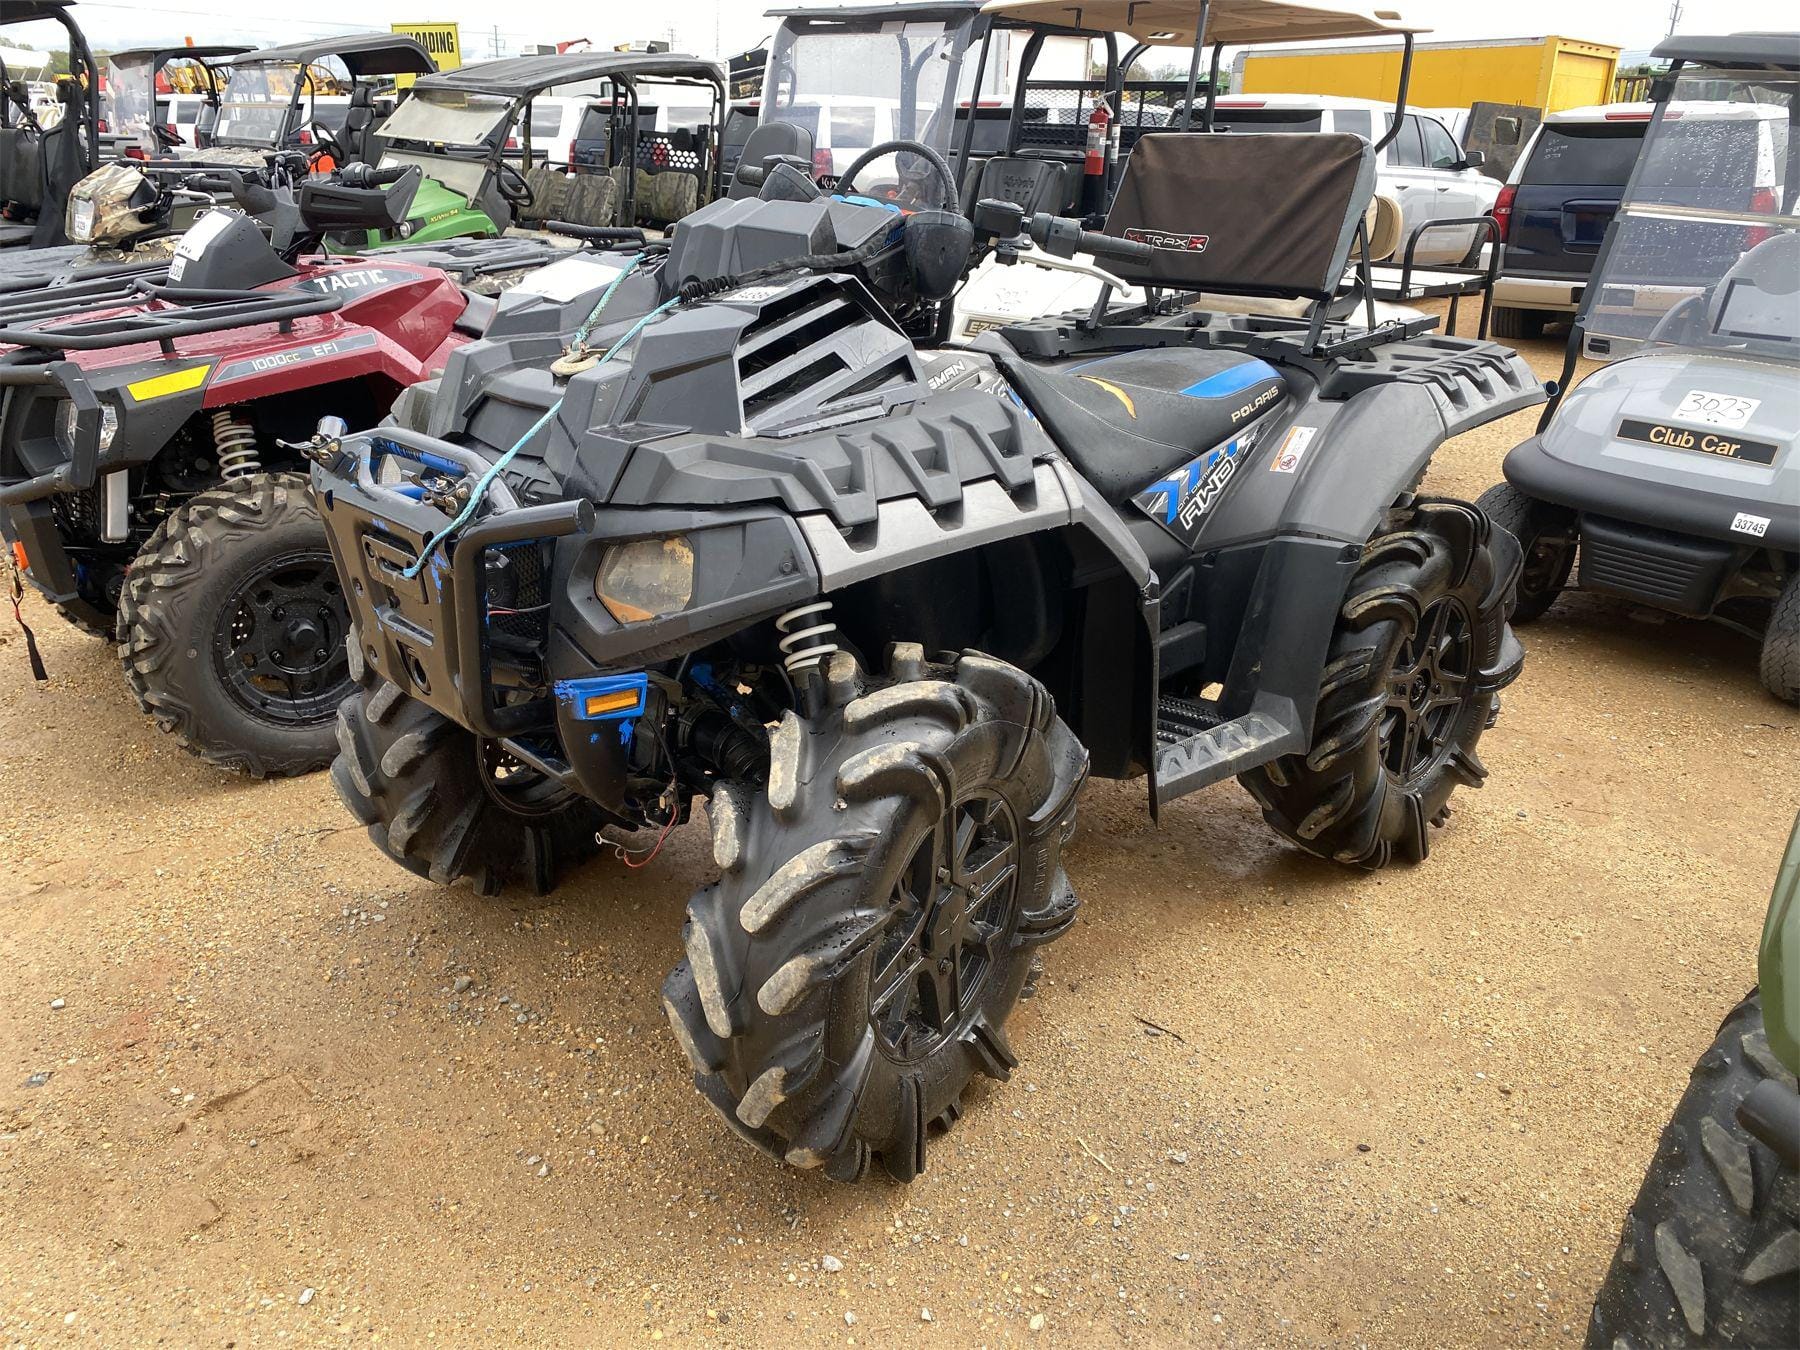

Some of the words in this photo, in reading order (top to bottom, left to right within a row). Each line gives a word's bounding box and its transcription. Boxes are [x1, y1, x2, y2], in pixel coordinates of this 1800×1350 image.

[313, 269, 388, 293] TACTIC
[251, 353, 301, 371] 1000cc
[311, 342, 338, 356] EFI
[1231, 385, 1279, 422] POLARIS
[1680, 393, 1752, 420] 3023
[1650, 426, 1695, 448] Club
[1701, 435, 1741, 457] Car
[1180, 456, 1236, 530] AWD
[1734, 518, 1766, 534] 33745
